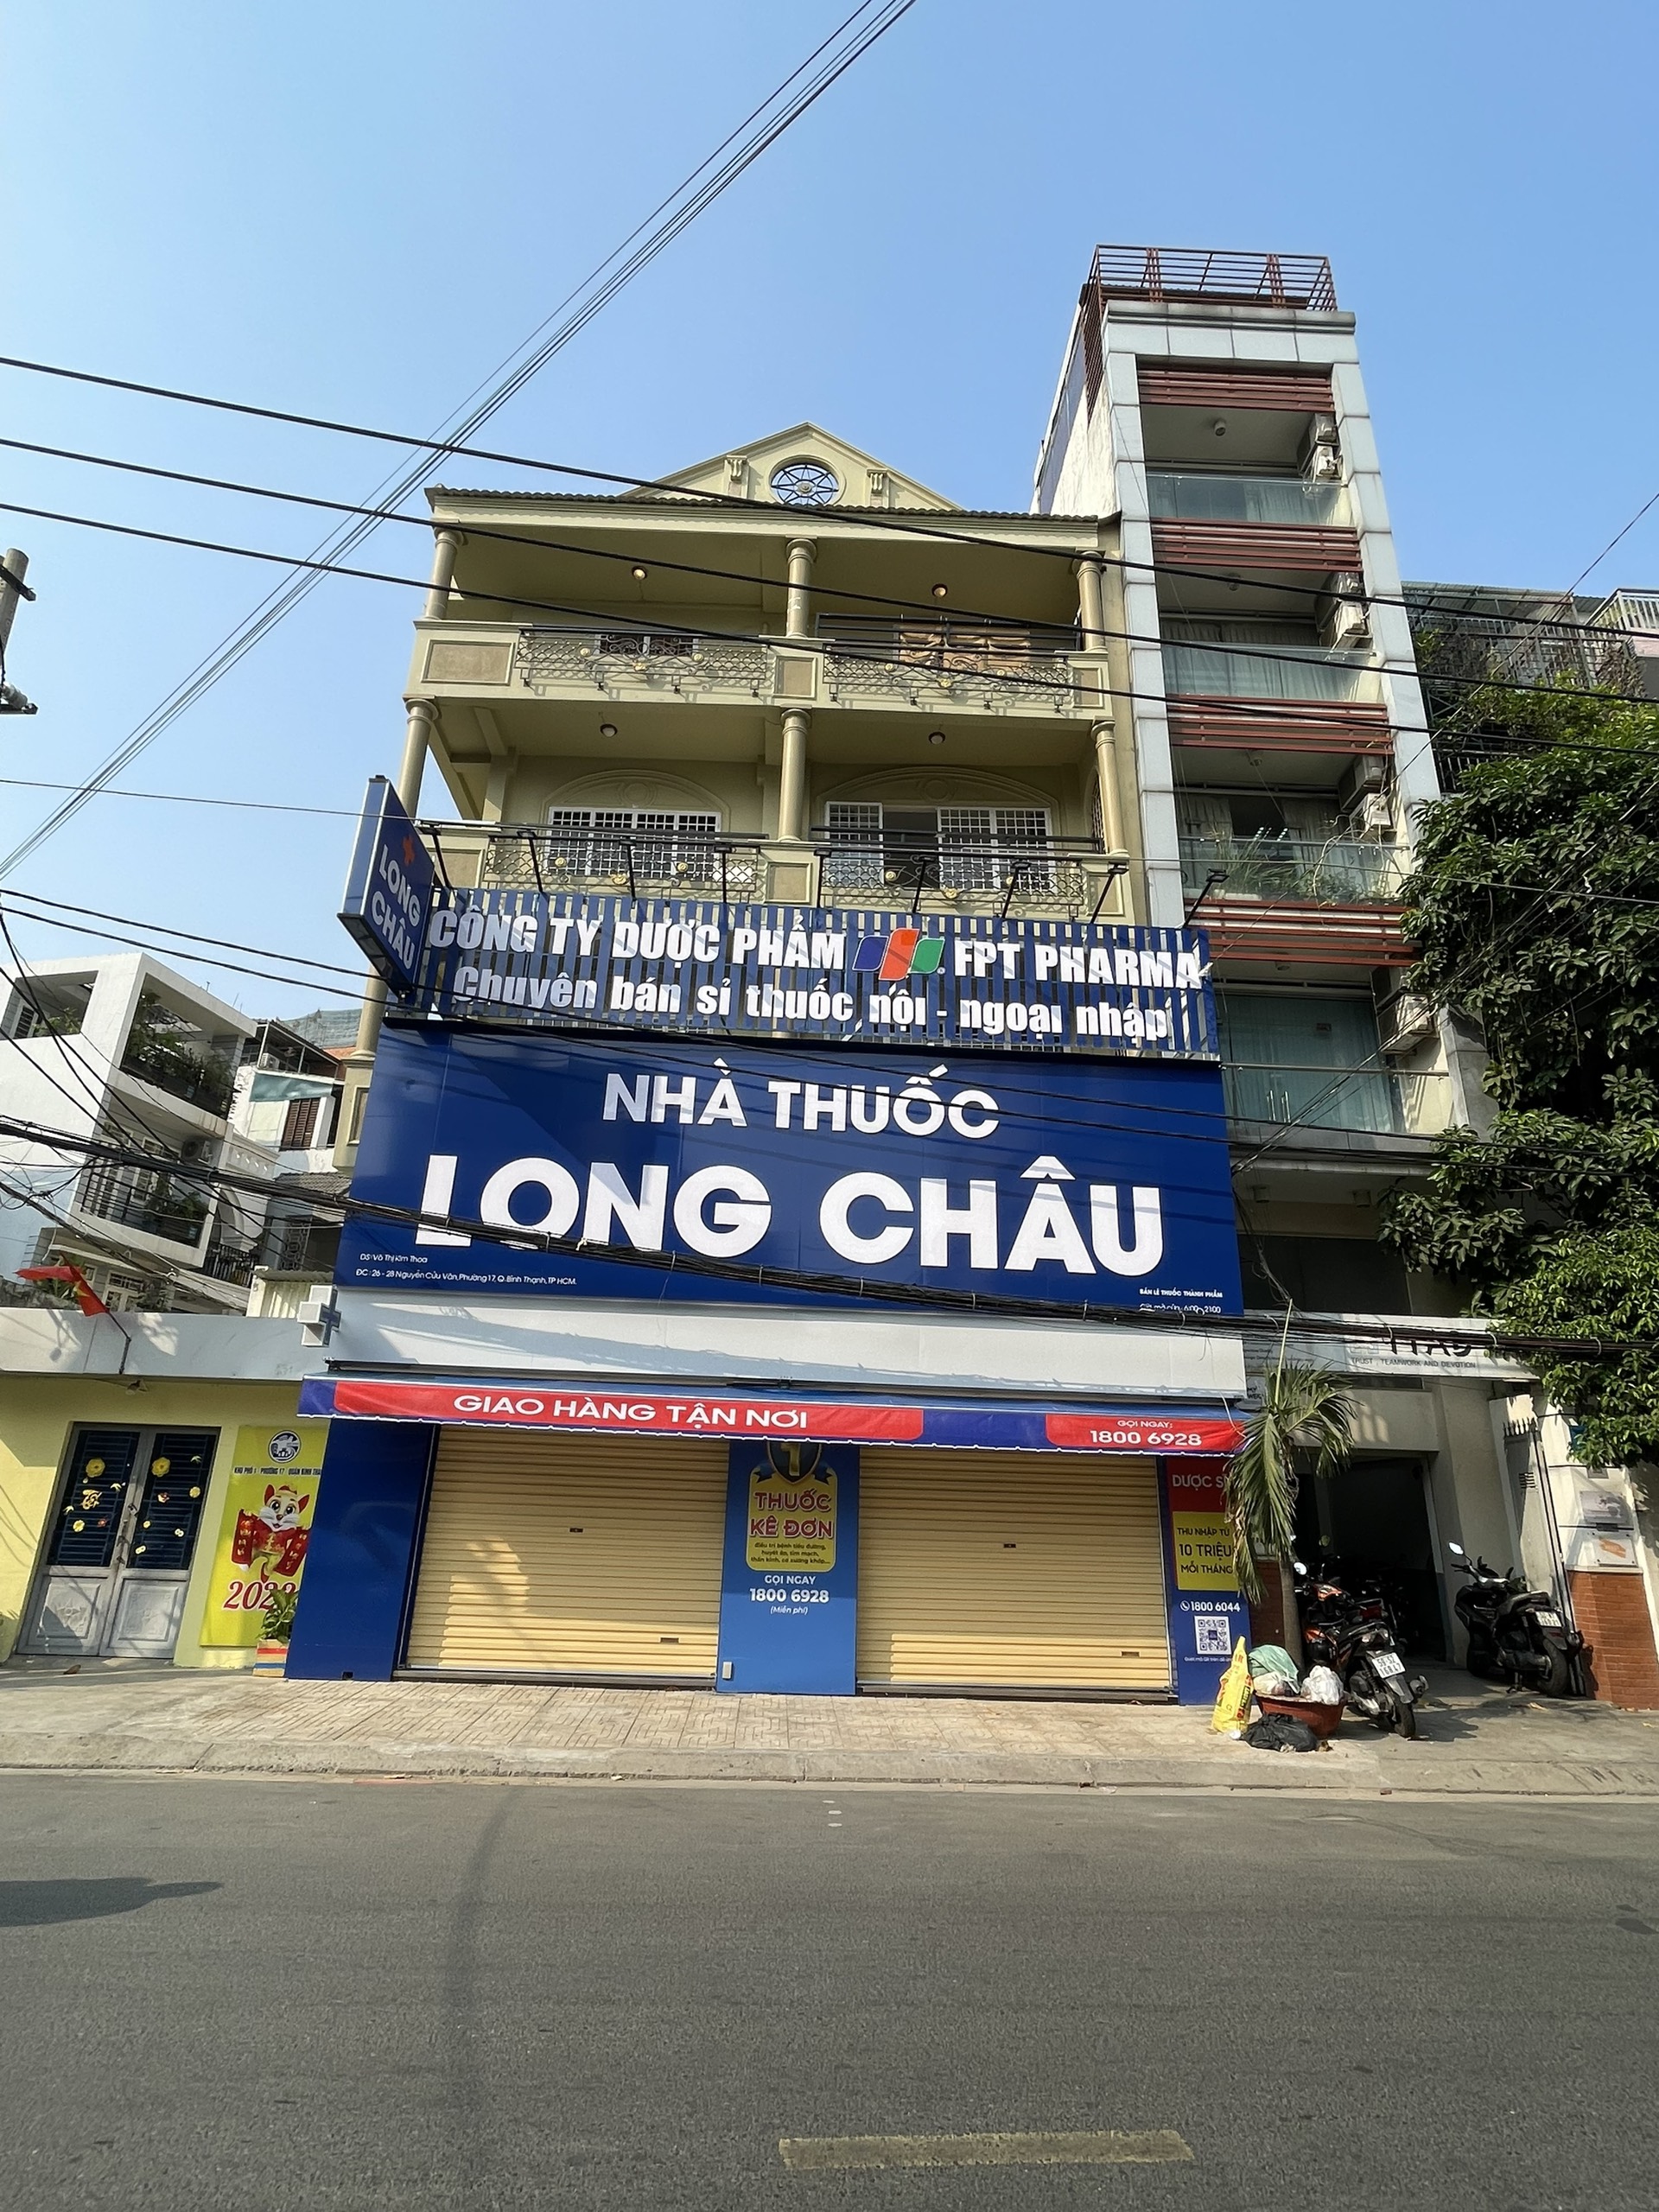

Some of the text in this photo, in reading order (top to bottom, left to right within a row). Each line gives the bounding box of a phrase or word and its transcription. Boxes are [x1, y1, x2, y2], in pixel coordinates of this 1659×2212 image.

[379, 843, 421, 927] LONG
[372, 891, 416, 969] CHÂU
[429, 905, 1202, 990] CÔNG TY DƯỢC PHẨM FPT PHARMA
[453, 965, 598, 1009] Chuyên
[610, 975, 682, 1013] bán
[746, 977, 854, 1021] thuốc
[960, 999, 1064, 1039] ngoại
[1076, 1001, 1167, 1044] nhập
[602, 1057, 1001, 1139] NHÀ THUỐC
[415, 1154, 1164, 1277] LONG CHÂU
[1139, 1287, 1153, 1295] BÁN
[1160, 1287, 1182, 1296] THUỐC
[1183, 1288, 1205, 1297] THÀNH
[1205, 1288, 1224, 1298] PHẨM
[453, 1394, 808, 1429] GIAO HÀNG TẬN NƠI
[1116, 1420, 1173, 1429] GỌI NGAY:
[1090, 1430, 1202, 1446] 1800 6928
[1172, 1473, 1212, 1491] DƯỢC
[753, 1488, 832, 1511] THUỐC
[749, 1515, 834, 1539] KÊ ĐƠN
[1177, 1527, 1195, 1536] THU
[1195, 1527, 1217, 1539] NHẬP
[1179, 1541, 1232, 1561] 10 TRIỆU
[1180, 1560, 1234, 1574] MỖI THÁNG
[764, 1574, 817, 1586] GỌI NGAY
[749, 1588, 830, 1603] 1800 6928
[1190, 1601, 1241, 1612] 1800 6044
